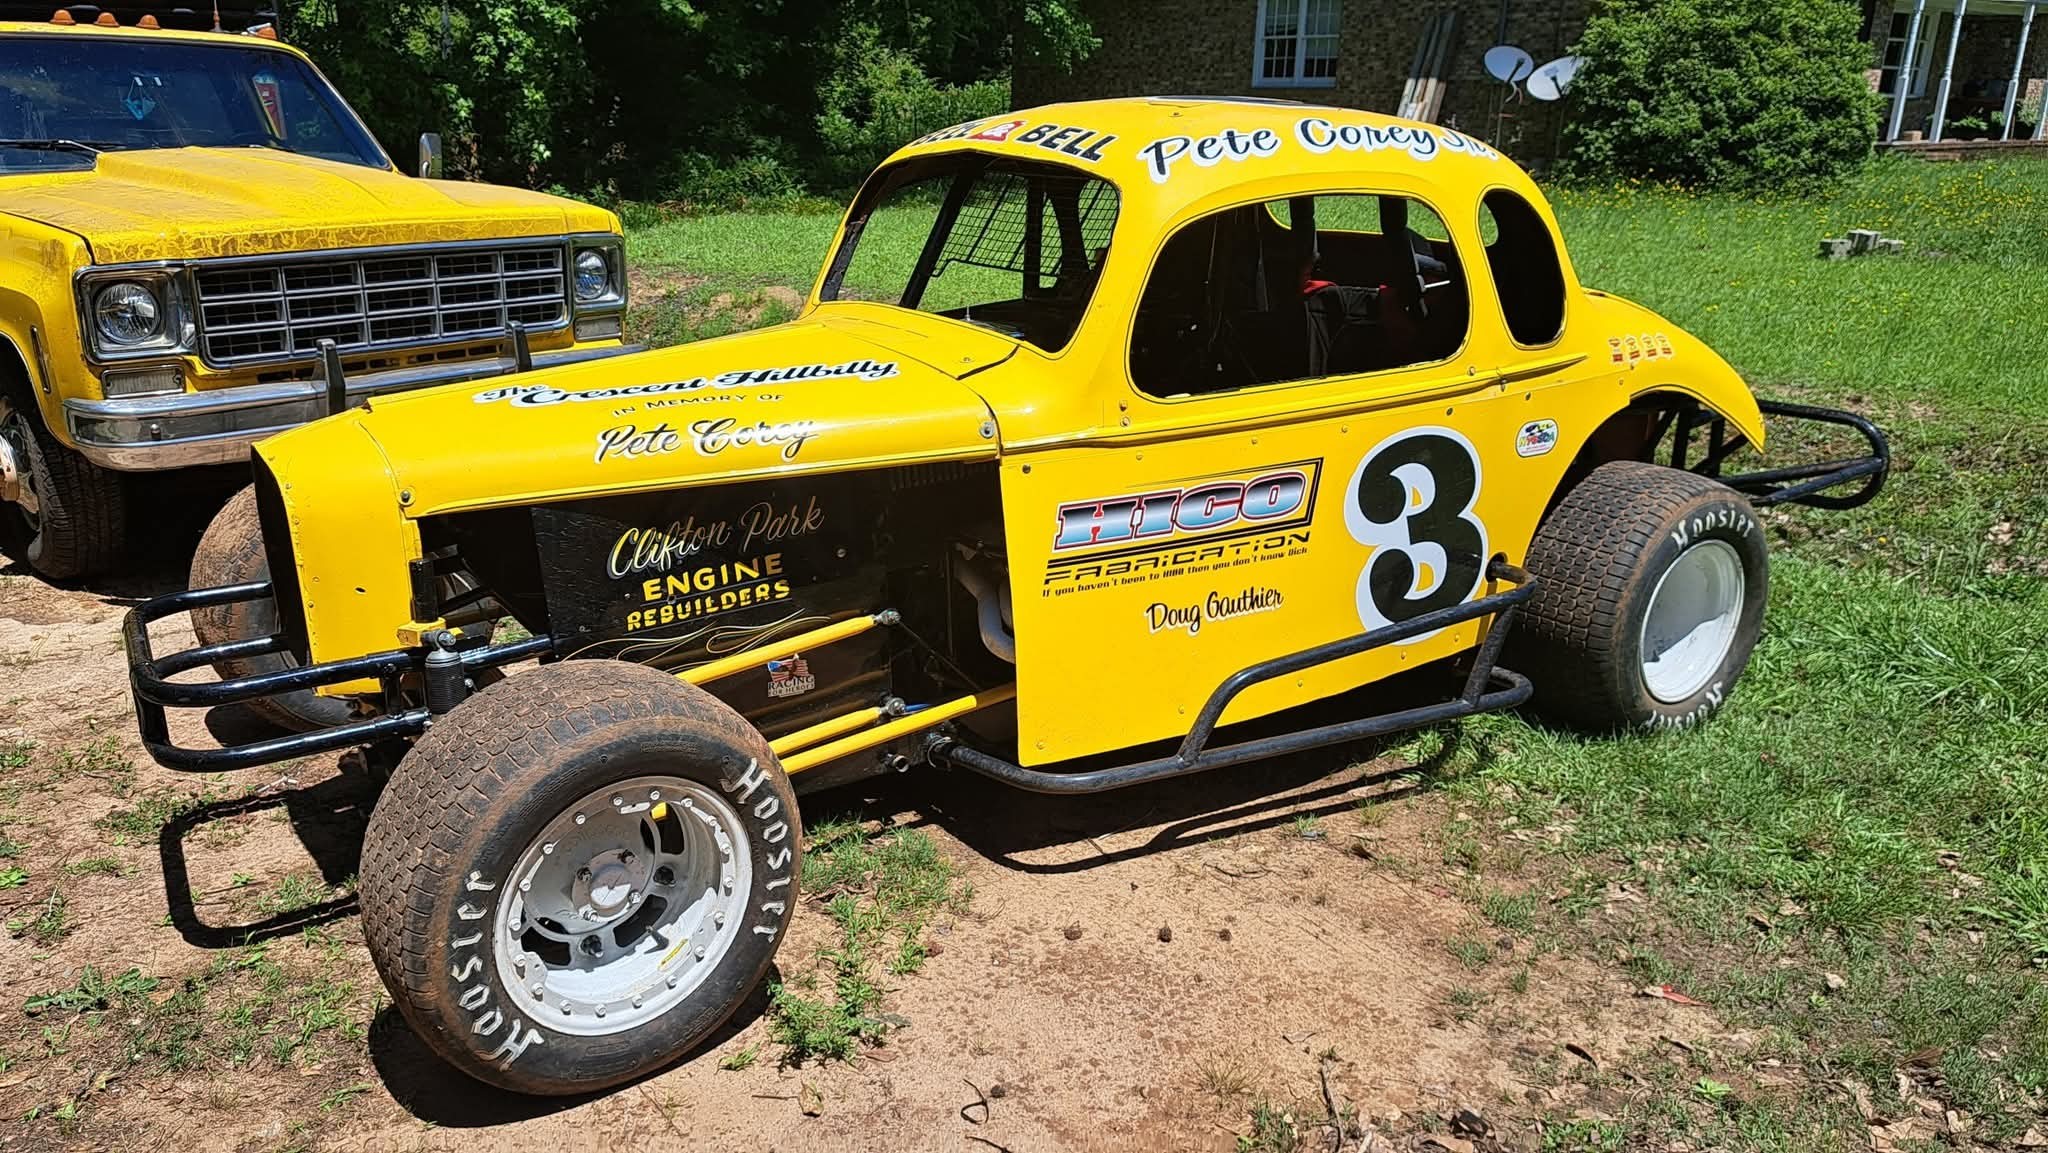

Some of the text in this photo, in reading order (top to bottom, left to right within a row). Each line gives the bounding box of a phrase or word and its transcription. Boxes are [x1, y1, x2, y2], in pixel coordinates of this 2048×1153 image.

[1015, 124, 1117, 162] BELL
[1142, 127, 1280, 178] Pete
[1299, 117, 1438, 158] Corey
[482, 360, 898, 406] The Crescent Hillbilly
[612, 392, 785, 417] IN MEMORY OF
[598, 417, 821, 463] Pete Corey
[1054, 471, 1307, 550] HICO
[1346, 430, 1487, 638] 3
[607, 495, 825, 580] Clifton Park
[642, 553, 785, 602] ENGINE
[1055, 586, 1075, 597] you
[1077, 577, 1118, 592] haven't
[1120, 575, 1146, 585] been
[1149, 572, 1160, 581] to
[1187, 564, 1210, 574] then
[1212, 561, 1231, 571] you
[1232, 554, 1258, 567] don't
[1260, 551, 1286, 562] know
[626, 579, 791, 633] REBUILDERS
[1147, 586, 1284, 632] Doug Gauthier
[768, 675, 815, 690] RACING
[725, 757, 793, 942] Hoosier
[450, 869, 545, 1066] Hoosier
